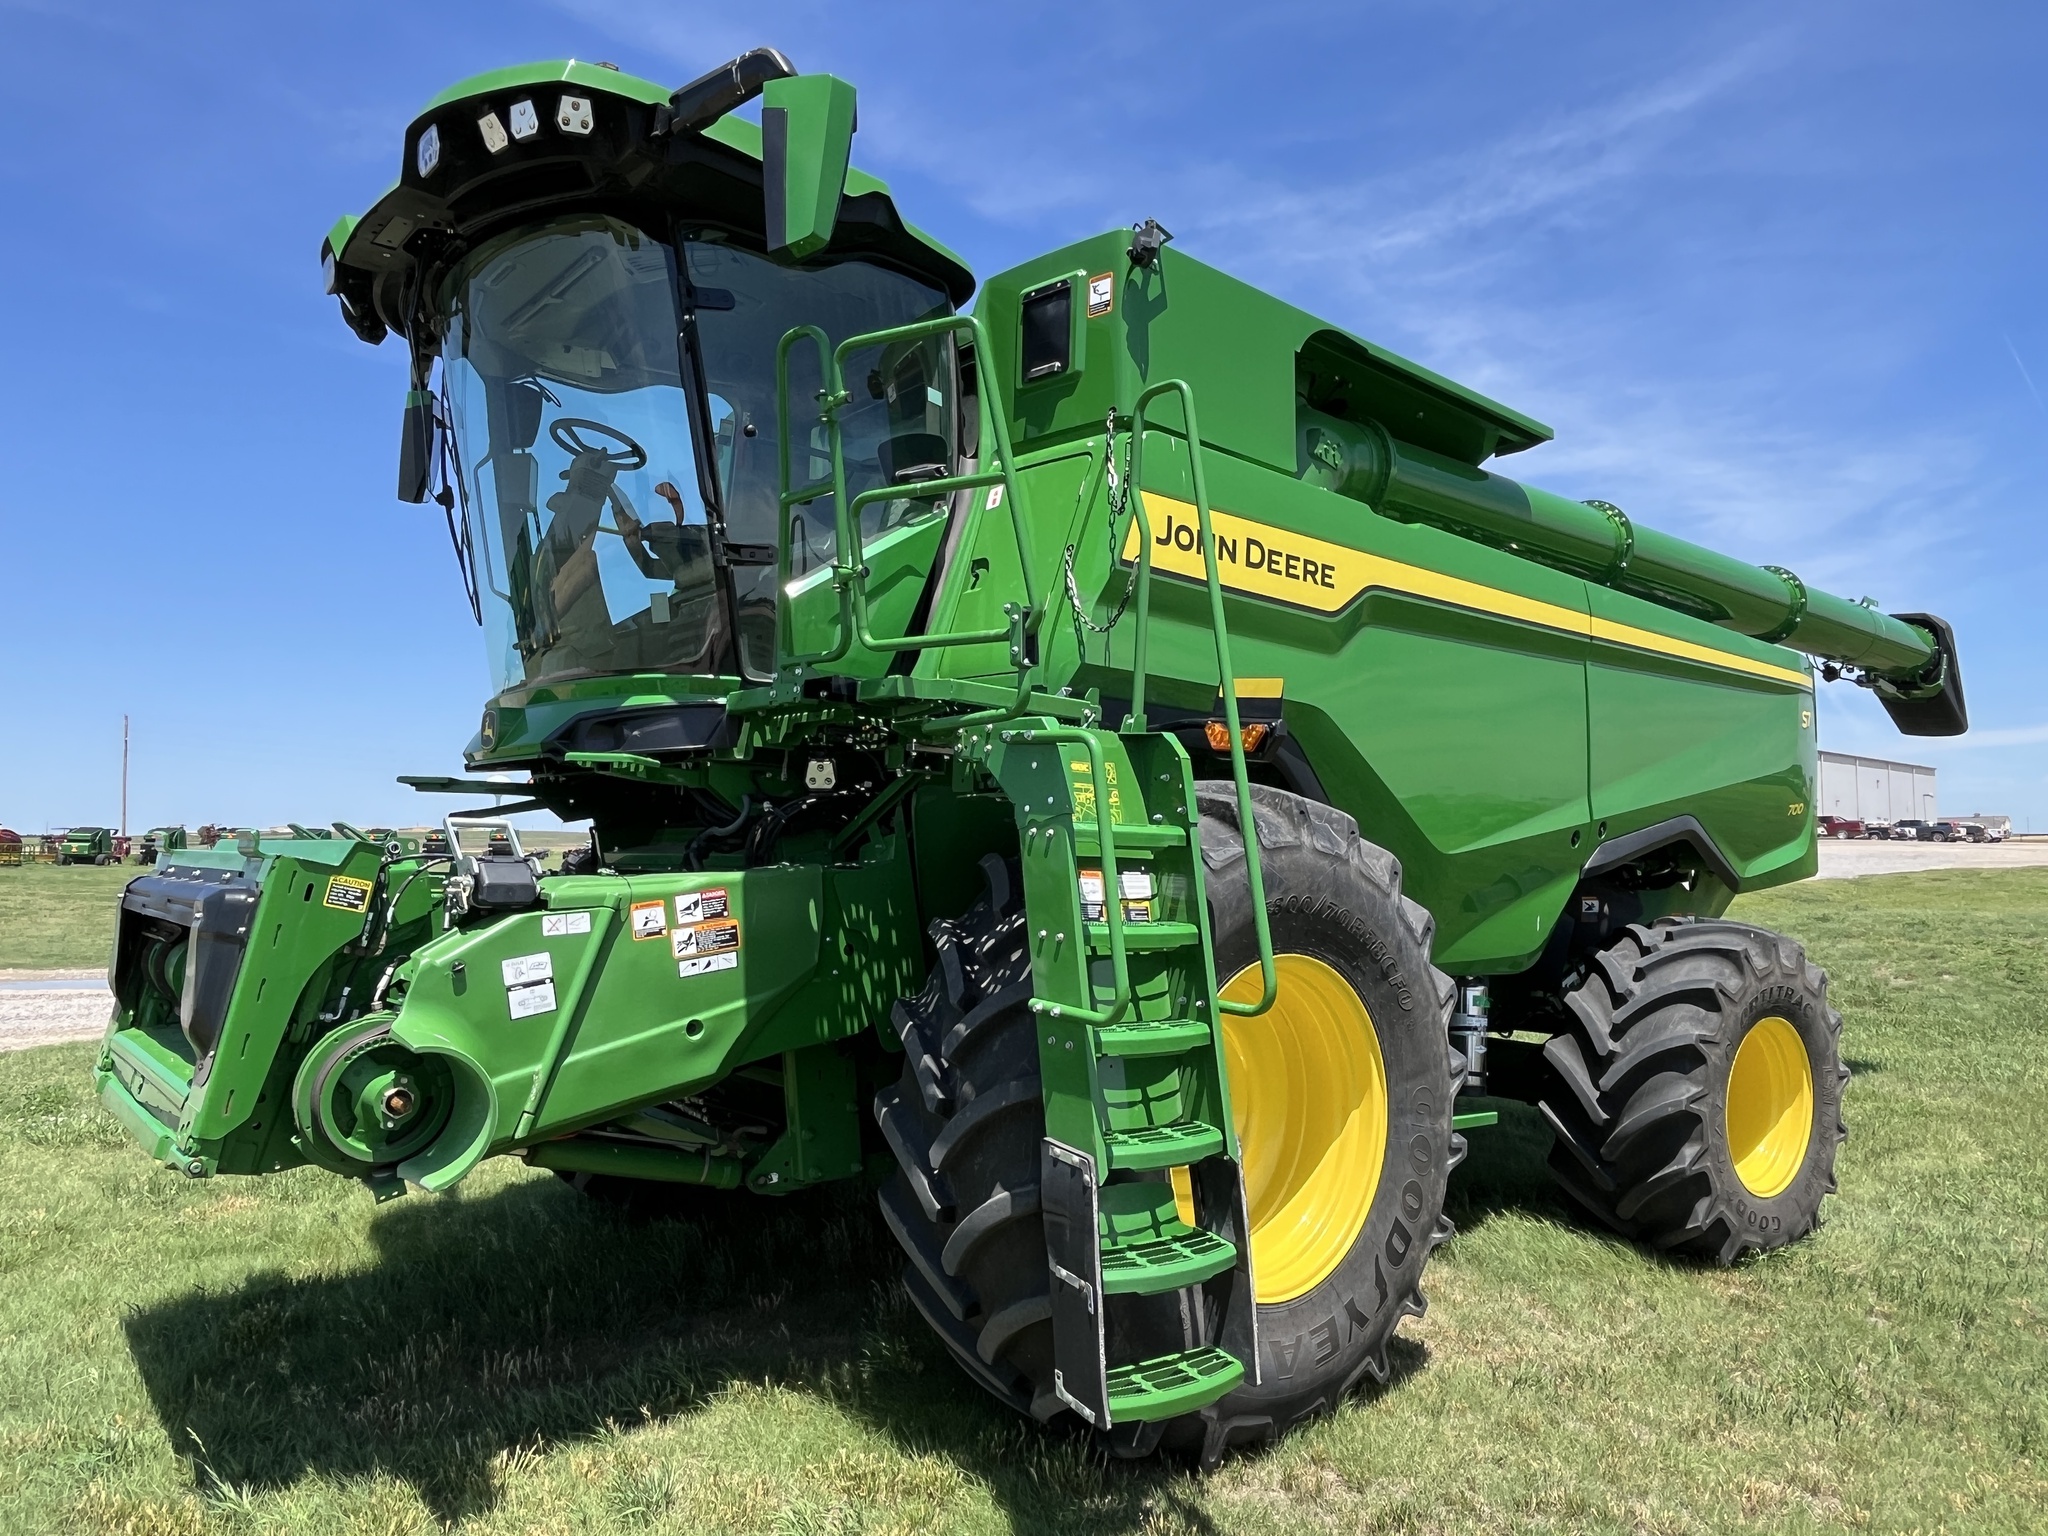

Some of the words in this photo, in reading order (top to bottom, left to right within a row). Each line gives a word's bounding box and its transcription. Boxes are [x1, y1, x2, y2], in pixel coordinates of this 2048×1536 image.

[1245, 537, 1335, 589] DEERE
[1801, 710, 1811, 729] S7
[1787, 803, 1804, 816] 700
[338, 877, 371, 889] CAUTION
[1259, 1085, 1438, 1381] GOODYEA
